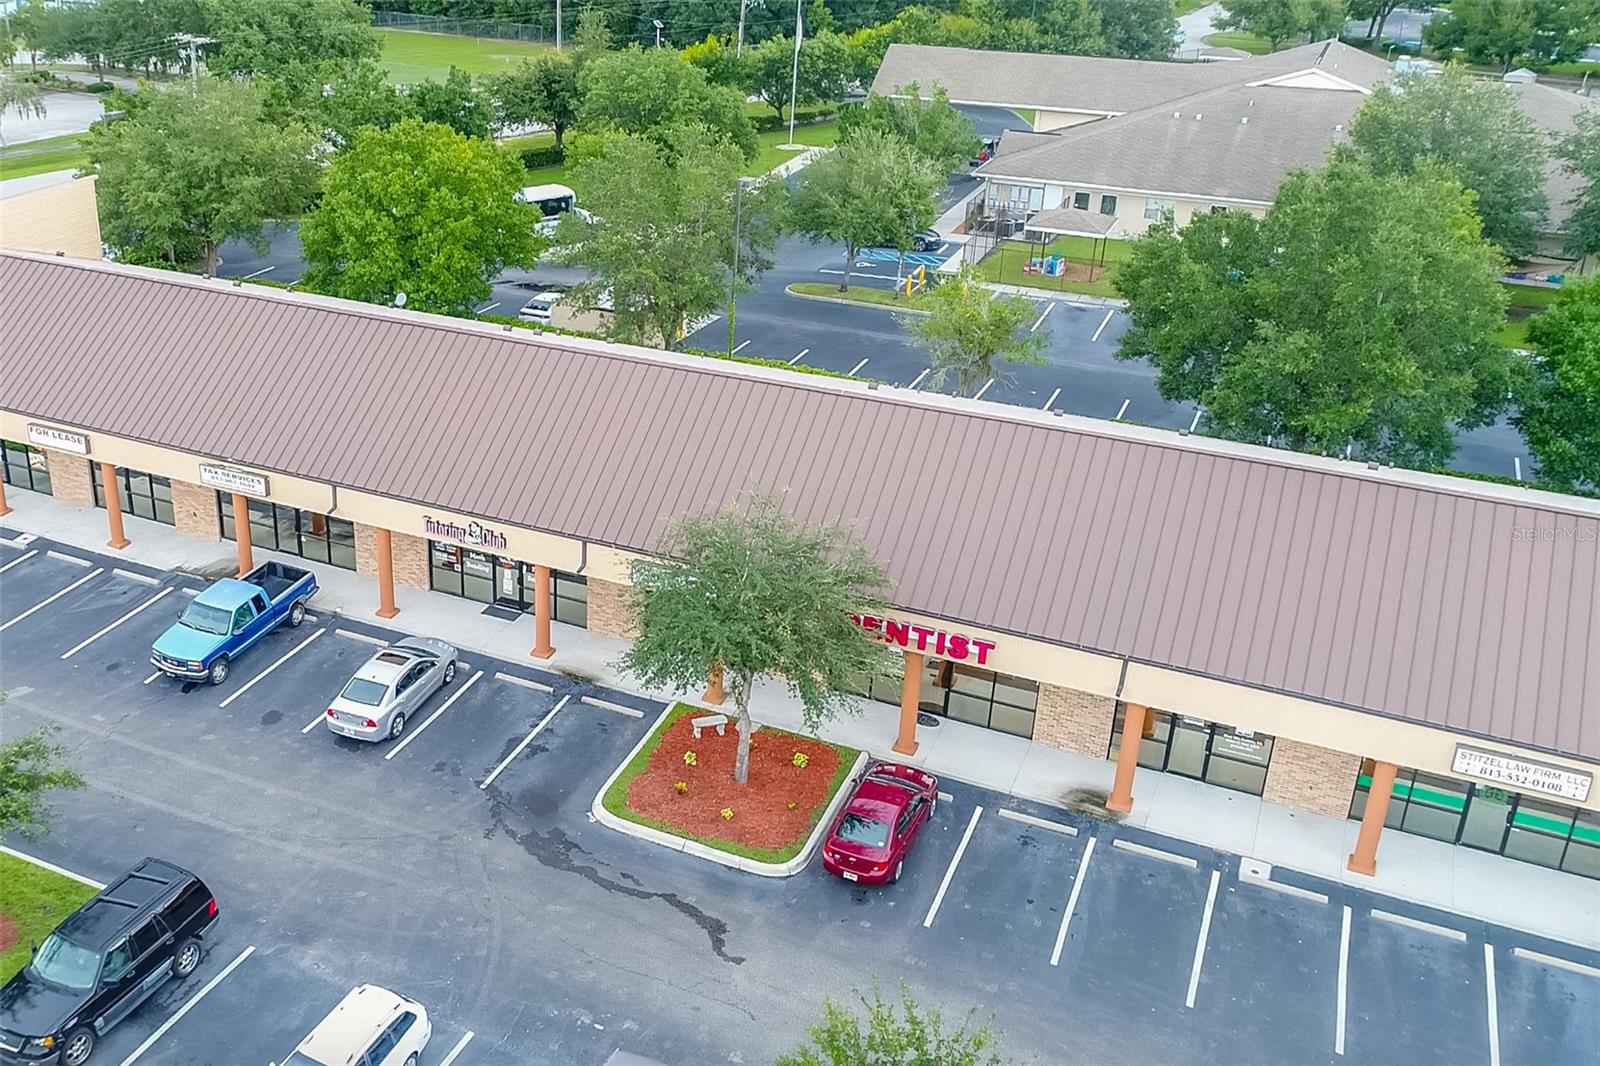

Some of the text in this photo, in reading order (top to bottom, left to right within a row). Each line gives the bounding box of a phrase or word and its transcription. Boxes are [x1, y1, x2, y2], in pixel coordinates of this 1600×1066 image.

[29, 426, 83, 445] FOR LEASE
[203, 467, 219, 475] TAX
[221, 471, 262, 485] SERVICES
[423, 515, 466, 543] Tutoring
[481, 528, 508, 550] Club
[1460, 751, 1503, 769] STITZEL
[1505, 761, 1531, 774] LAW
[1566, 775, 1589, 788] LLC
[1479, 766, 1562, 793] 813-532-0108
